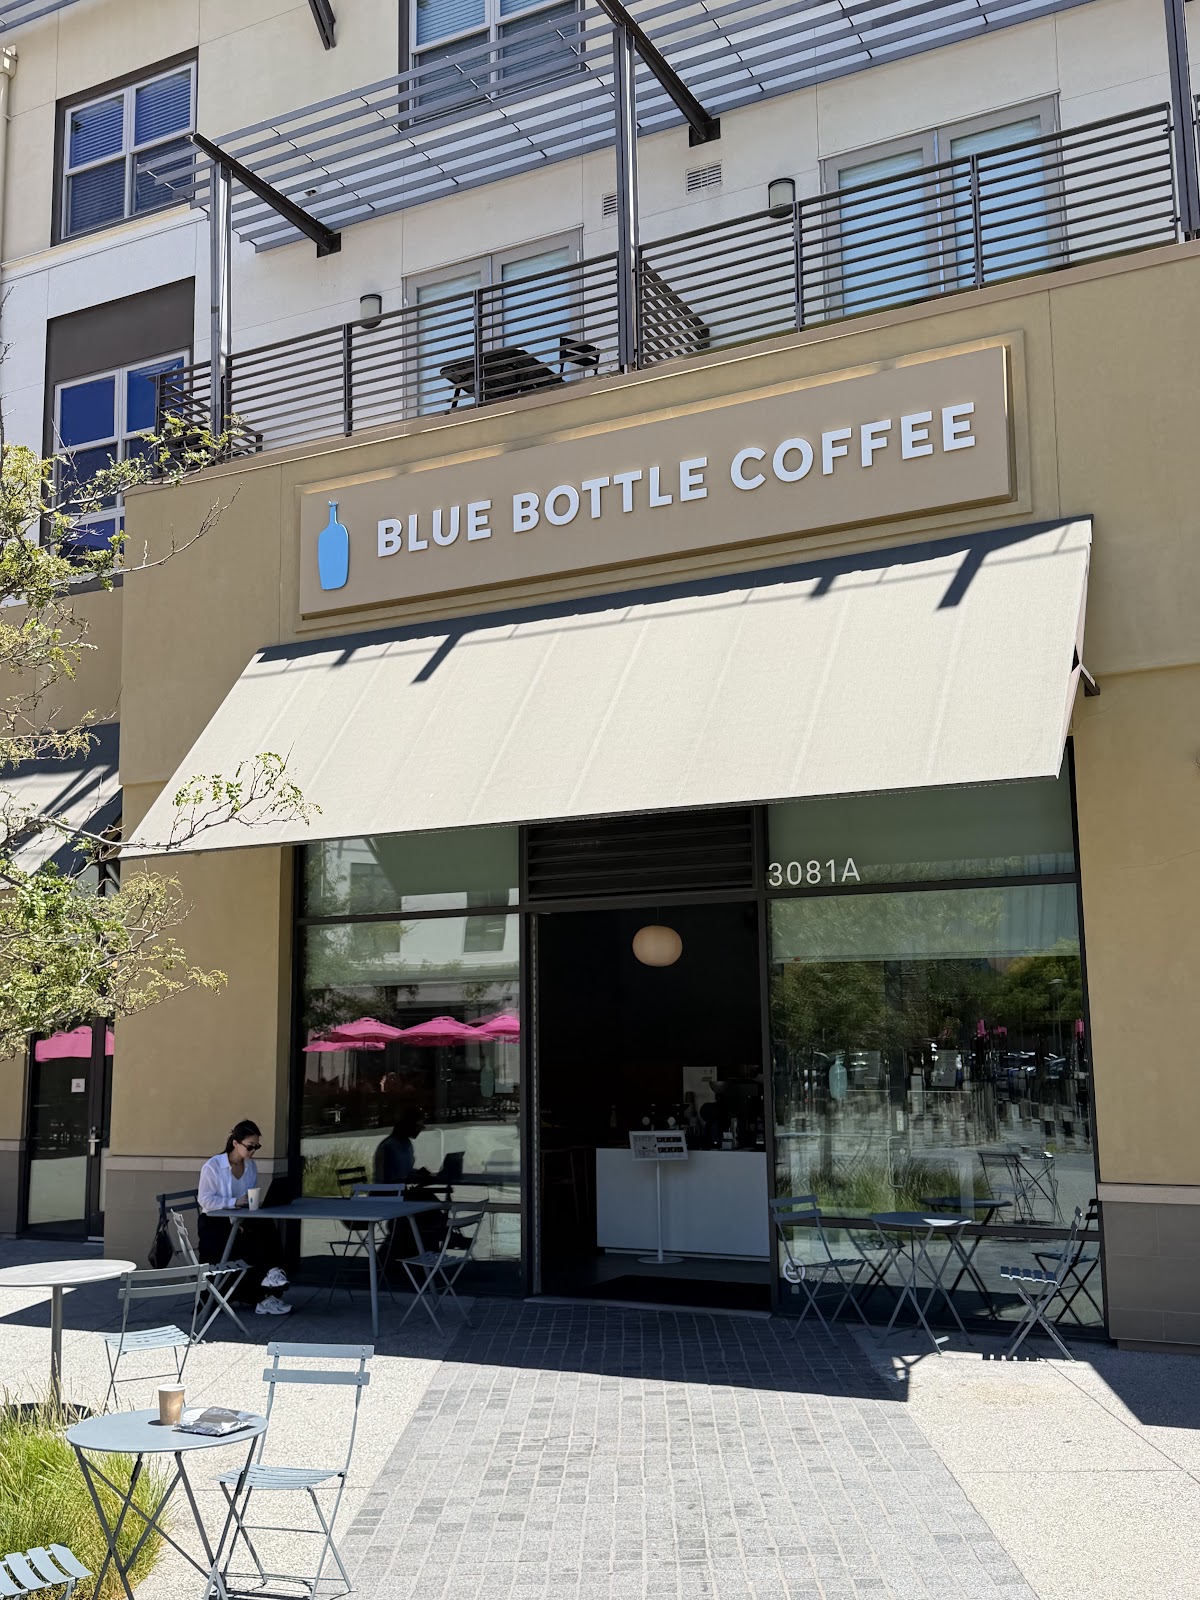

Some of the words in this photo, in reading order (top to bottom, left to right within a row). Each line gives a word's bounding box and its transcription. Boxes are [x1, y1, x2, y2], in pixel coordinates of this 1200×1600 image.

[376, 499, 492, 558] BLUE
[512, 456, 708, 534] BOTTLE
[729, 401, 977, 491] COFFEE
[768, 857, 861, 887] 3081A
